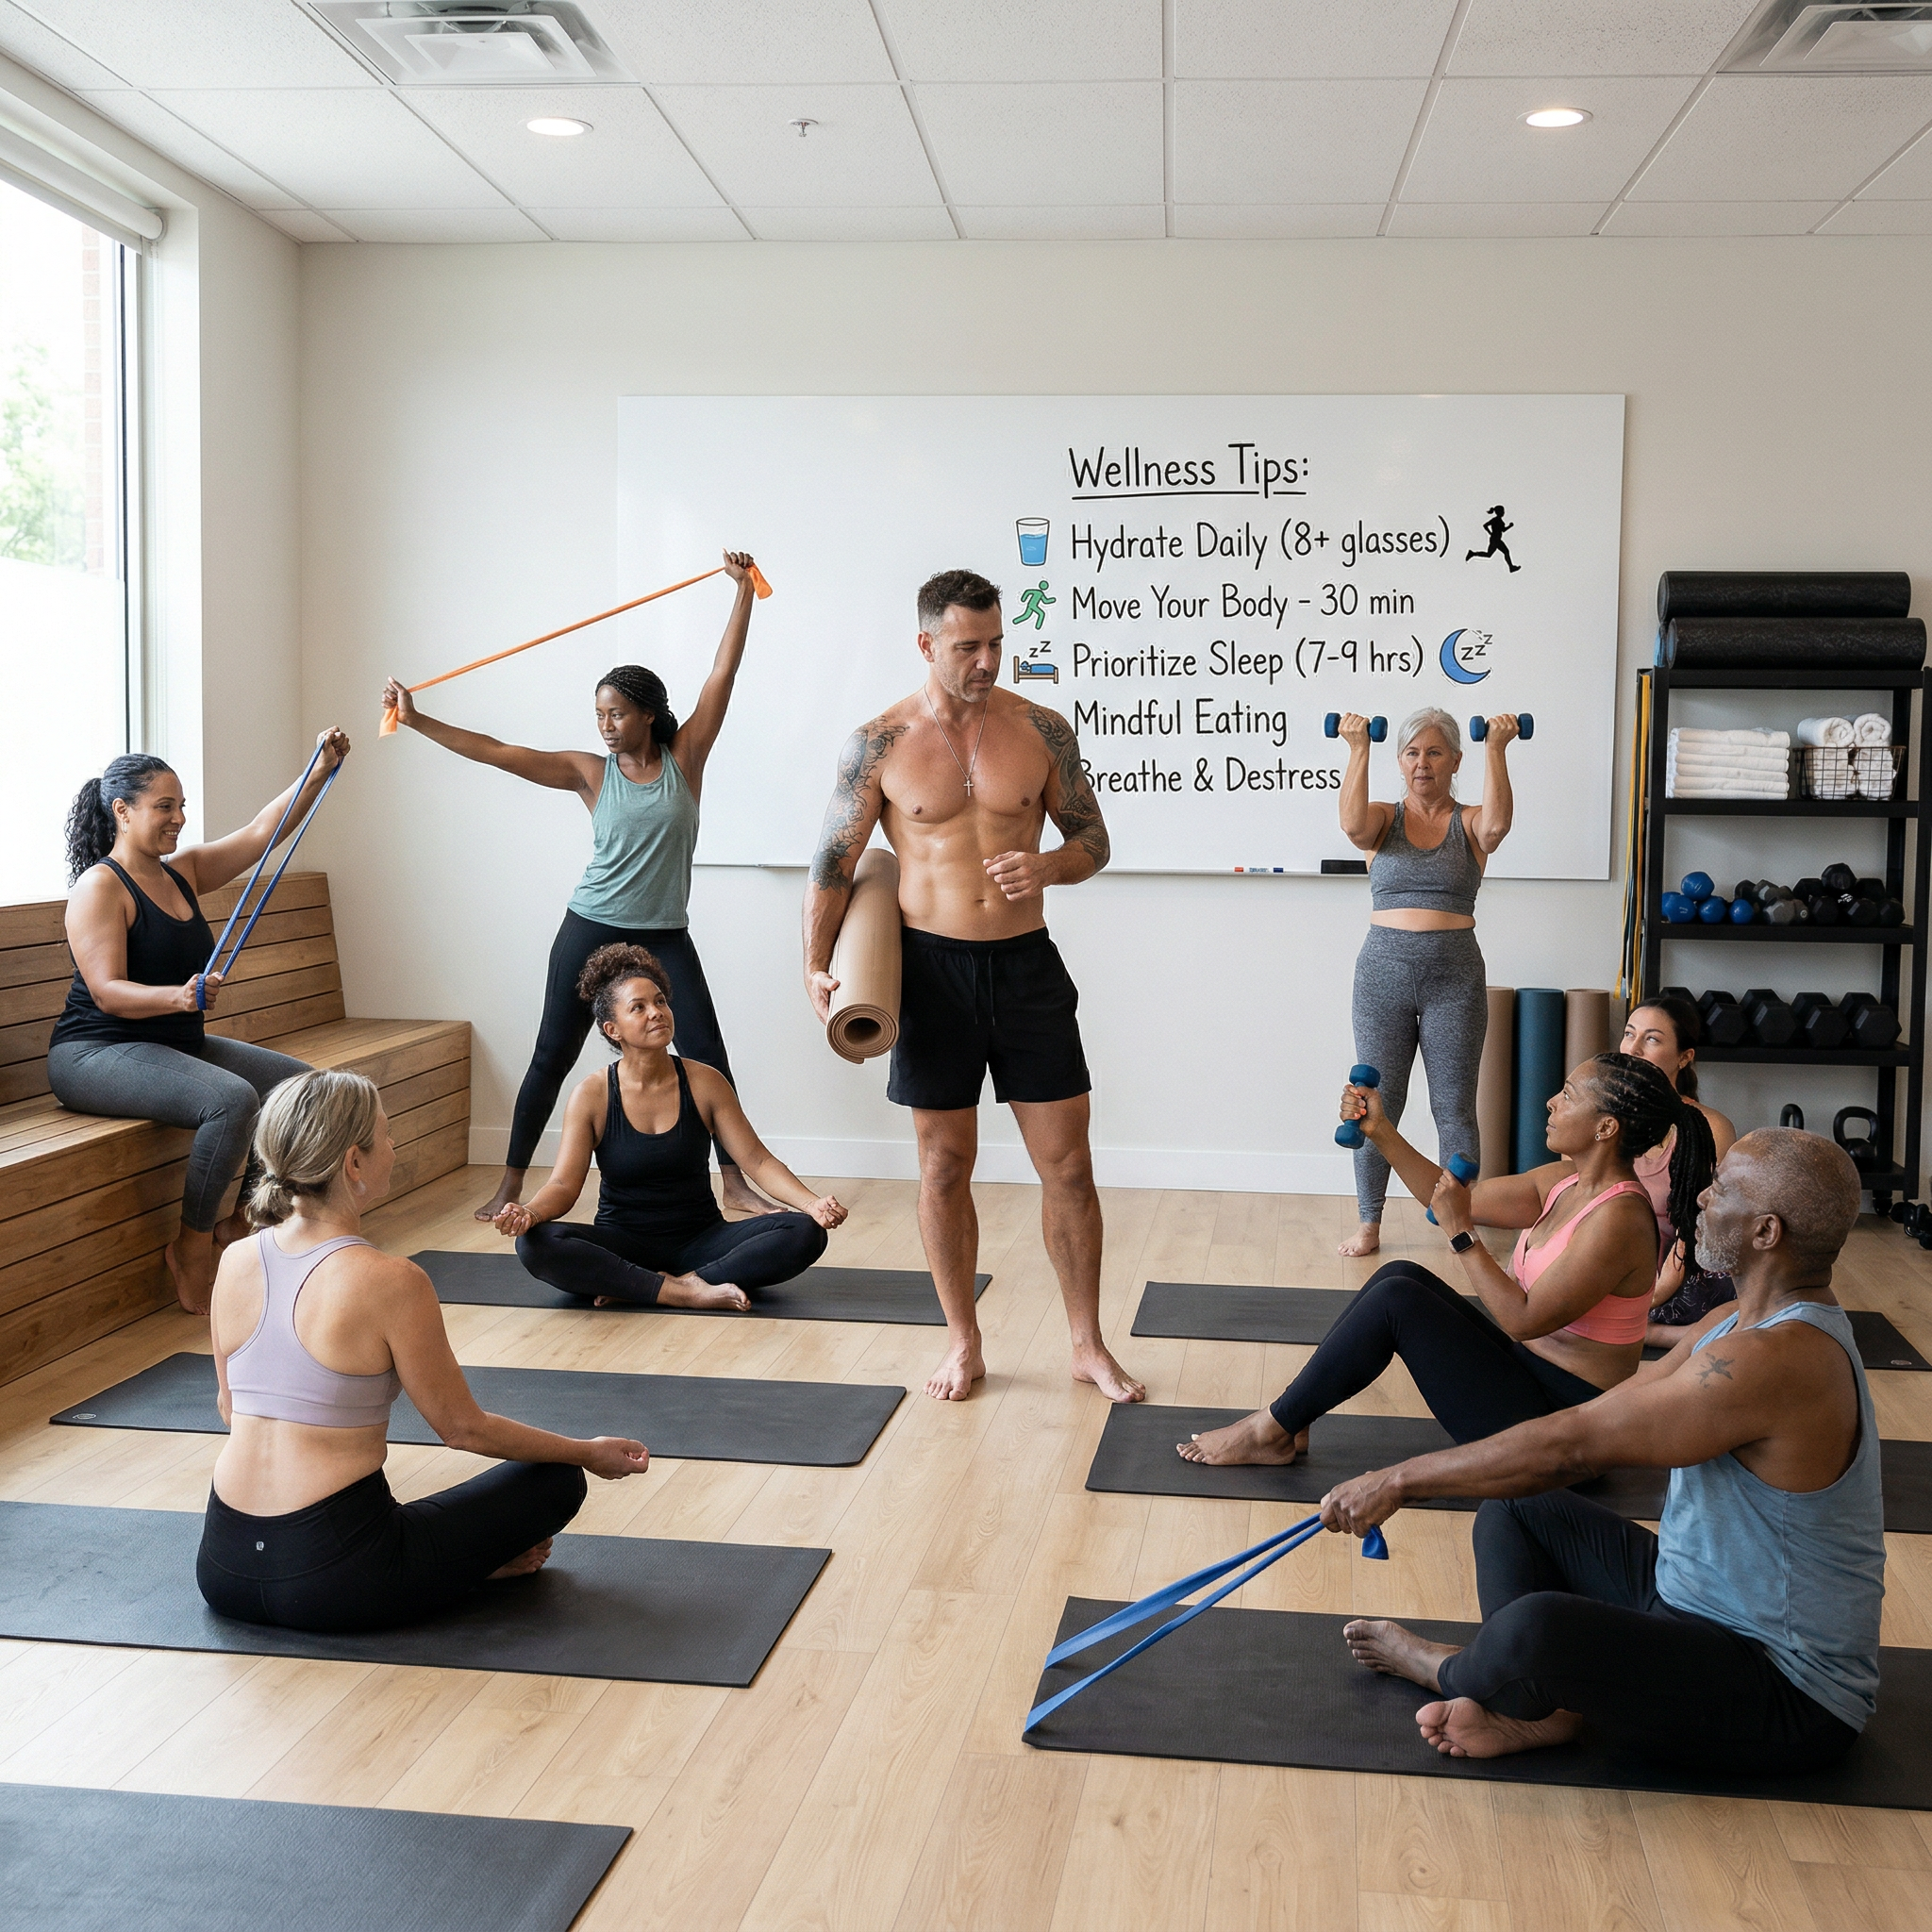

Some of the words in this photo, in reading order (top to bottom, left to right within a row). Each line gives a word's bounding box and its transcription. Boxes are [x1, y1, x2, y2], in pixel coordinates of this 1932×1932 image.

[1068, 446, 1216, 489] Wellness
[1227, 442, 1310, 500] Tips:
[1072, 524, 1184, 574] Hydrate
[1196, 518, 1268, 571] Daily
[1280, 518, 1330, 561] (8+
[1341, 515, 1451, 568] glasses)
[1073, 586, 1141, 620] Move
[1150, 584, 1209, 619] Your
[1222, 583, 1289, 630] Body
[1320, 583, 1358, 616] 30
[1370, 590, 1414, 615] min
[1073, 642, 1197, 678] Prioritize
[1208, 640, 1284, 686] Sleep
[1370, 634, 1424, 678] hrs)
[1074, 699, 1181, 736] Mindful
[1195, 697, 1287, 747] Eating
[1193, 757, 1215, 792] &
[1225, 756, 1341, 792] Destress
